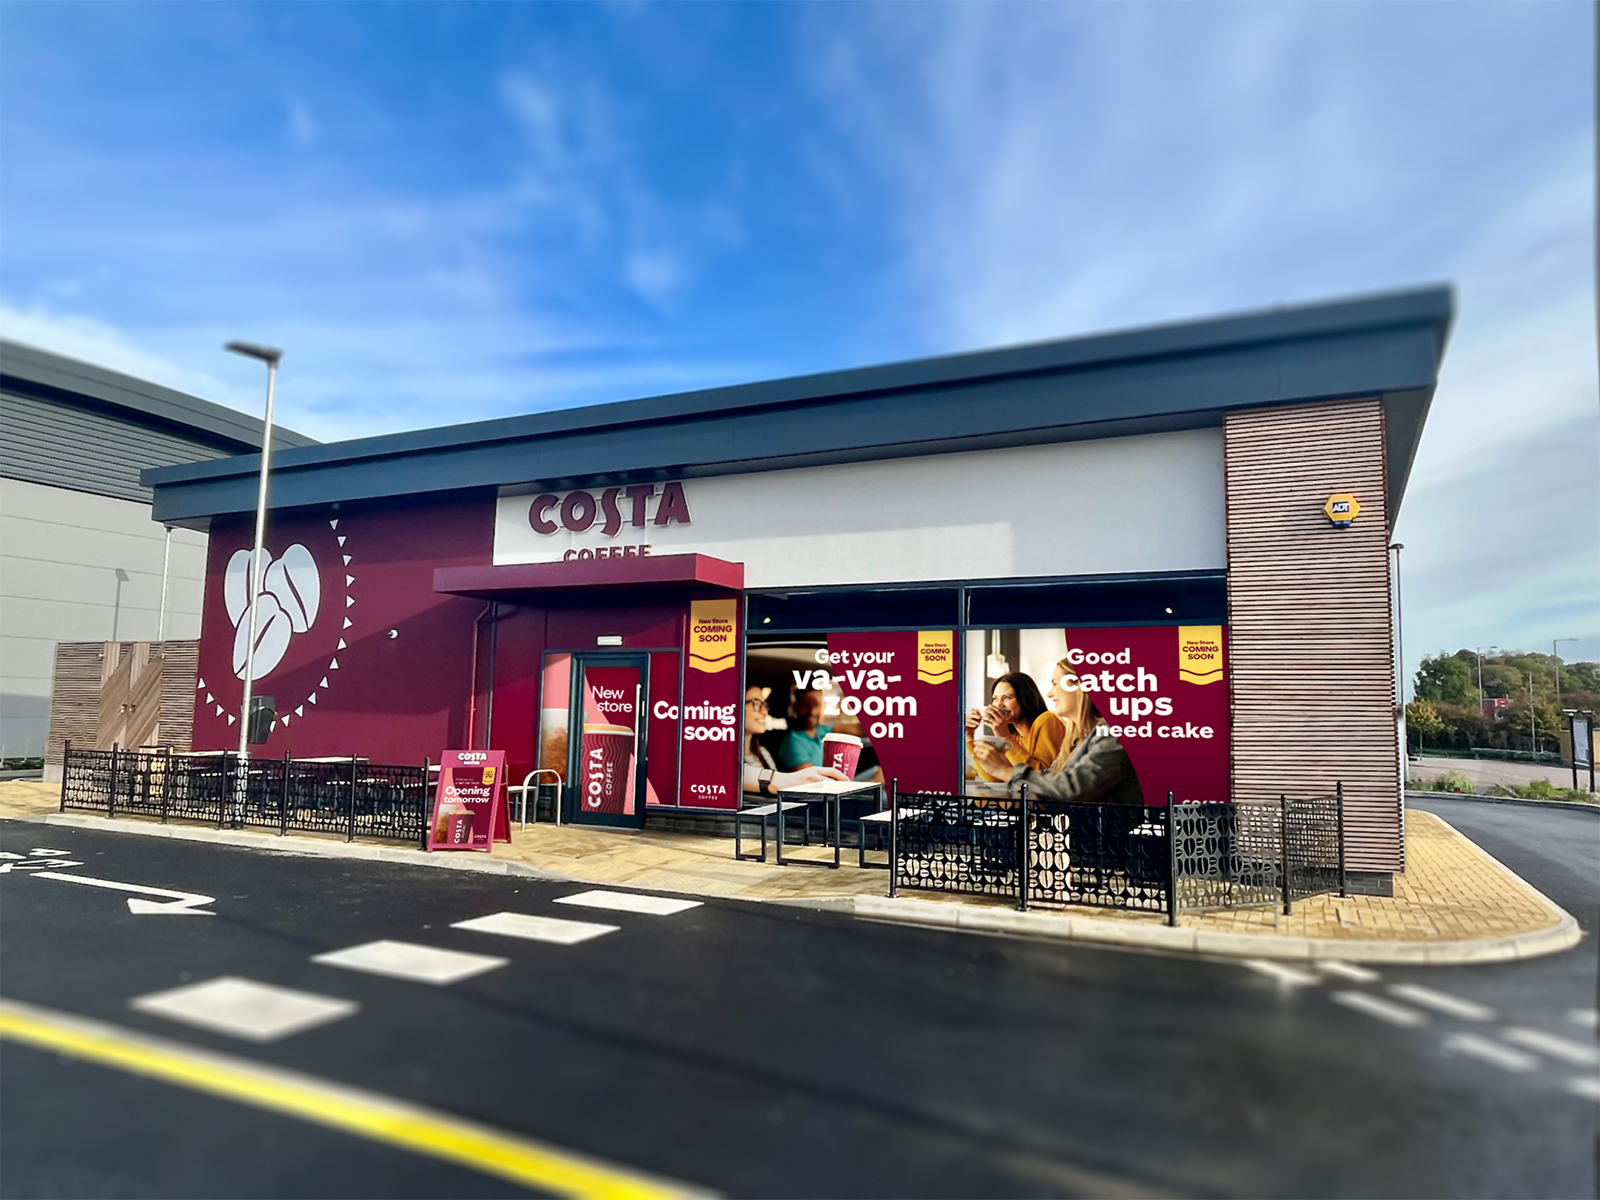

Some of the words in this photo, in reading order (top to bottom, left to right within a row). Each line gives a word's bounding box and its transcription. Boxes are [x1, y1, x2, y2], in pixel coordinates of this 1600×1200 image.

[528, 481, 692, 538] COSTA
[1332, 502, 1349, 512] ADT
[693, 625, 733, 634] COMING
[698, 634, 728, 643] SOON
[814, 648, 849, 665] Get
[852, 651, 895, 667] your
[1066, 647, 1131, 665] Good
[1182, 645, 1219, 653] COMING
[792, 669, 902, 690] va-va-
[1059, 666, 1158, 692] catch
[591, 685, 625, 700] New
[597, 700, 633, 713] store
[653, 700, 736, 725] Coming
[823, 695, 917, 716] zoom
[1109, 696, 1174, 721] ups
[684, 726, 736, 742] soon
[869, 721, 904, 739] on
[1095, 721, 1152, 738] need
[1156, 722, 1214, 739] cake
[458, 752, 487, 762] COSTA
[588, 747, 604, 808] COSTA
[605, 761, 614, 796] COFFEE
[445, 785, 490, 797] Opening
[690, 784, 726, 795] COSTA
[443, 796, 490, 804] tomorrow
[453, 819, 463, 844] COSTA
